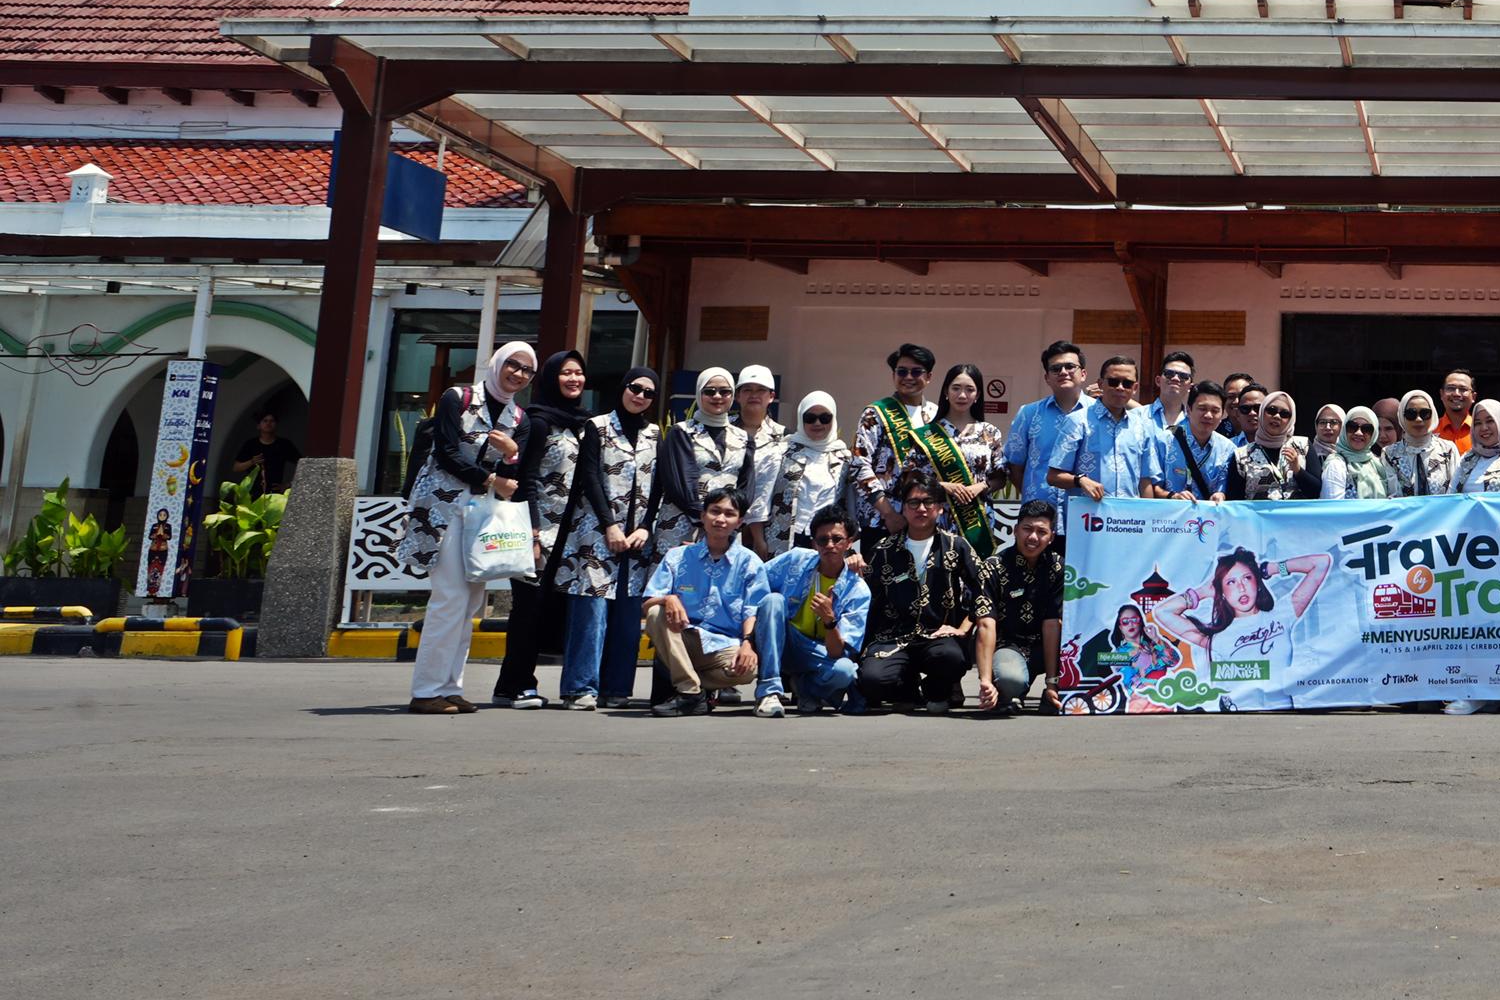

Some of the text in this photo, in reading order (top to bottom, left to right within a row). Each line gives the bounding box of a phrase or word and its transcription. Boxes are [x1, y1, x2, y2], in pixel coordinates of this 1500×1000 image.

[172, 389, 191, 399] KAI
[885, 407, 909, 442] JAJAKA
[928, 431, 957, 469] MOJANG
[1106, 516, 1146, 526] Danantara
[1106, 525, 1144, 534] Indonesia
[478, 531, 527, 545] Traveling
[1413, 569, 1428, 591] by
[1422, 644, 1443, 652] APRIL
[1307, 677, 1369, 686] COLLABORATION
[1392, 673, 1419, 685] TikTok
[1428, 677, 1448, 685] Hotel
[1450, 677, 1479, 685] Santika
